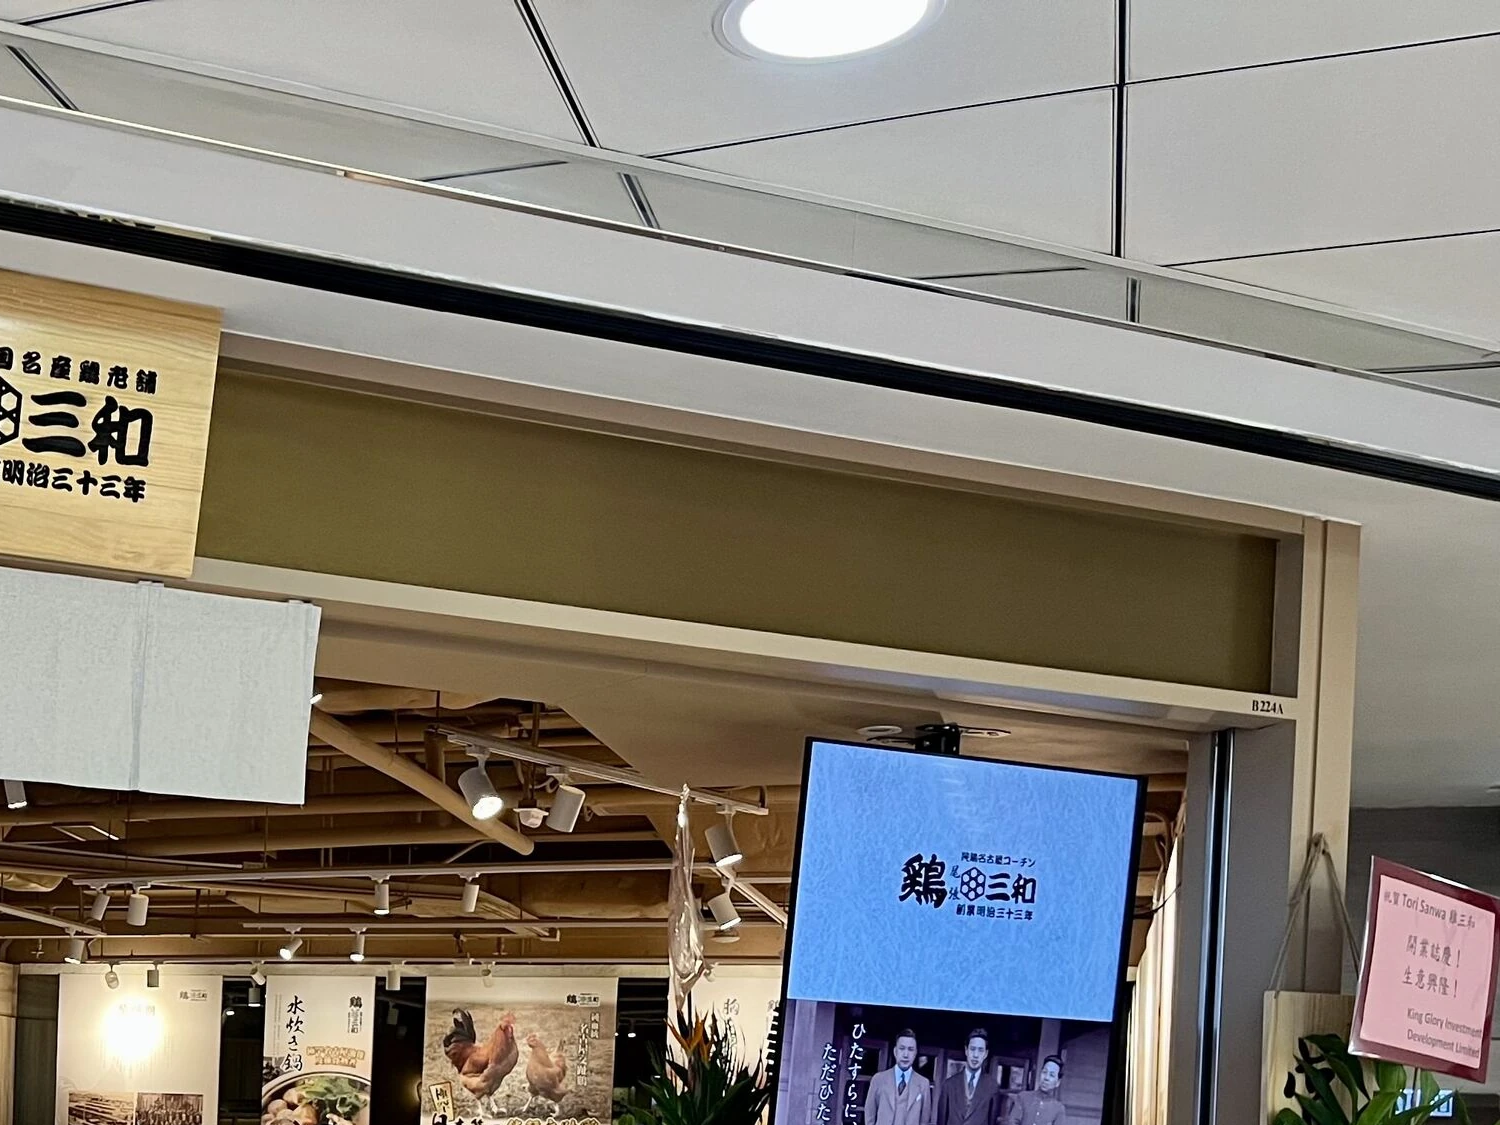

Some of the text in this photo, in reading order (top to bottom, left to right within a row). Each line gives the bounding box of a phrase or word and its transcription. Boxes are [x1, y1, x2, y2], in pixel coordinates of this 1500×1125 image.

[21, 390, 152, 467] 三和
[1252, 700, 1284, 715] B224A
[985, 872, 1037, 905] 三和
[956, 904, 1033, 921] 創業明治三十三年
[1402, 893, 1420, 912] Tori
[1419, 899, 1447, 921] Sanwa
[280, 995, 306, 1072] 水炊き鍋
[1407, 1008, 1482, 1038] King Glory Investment
[1407, 1028, 1480, 1059] Development Limited
